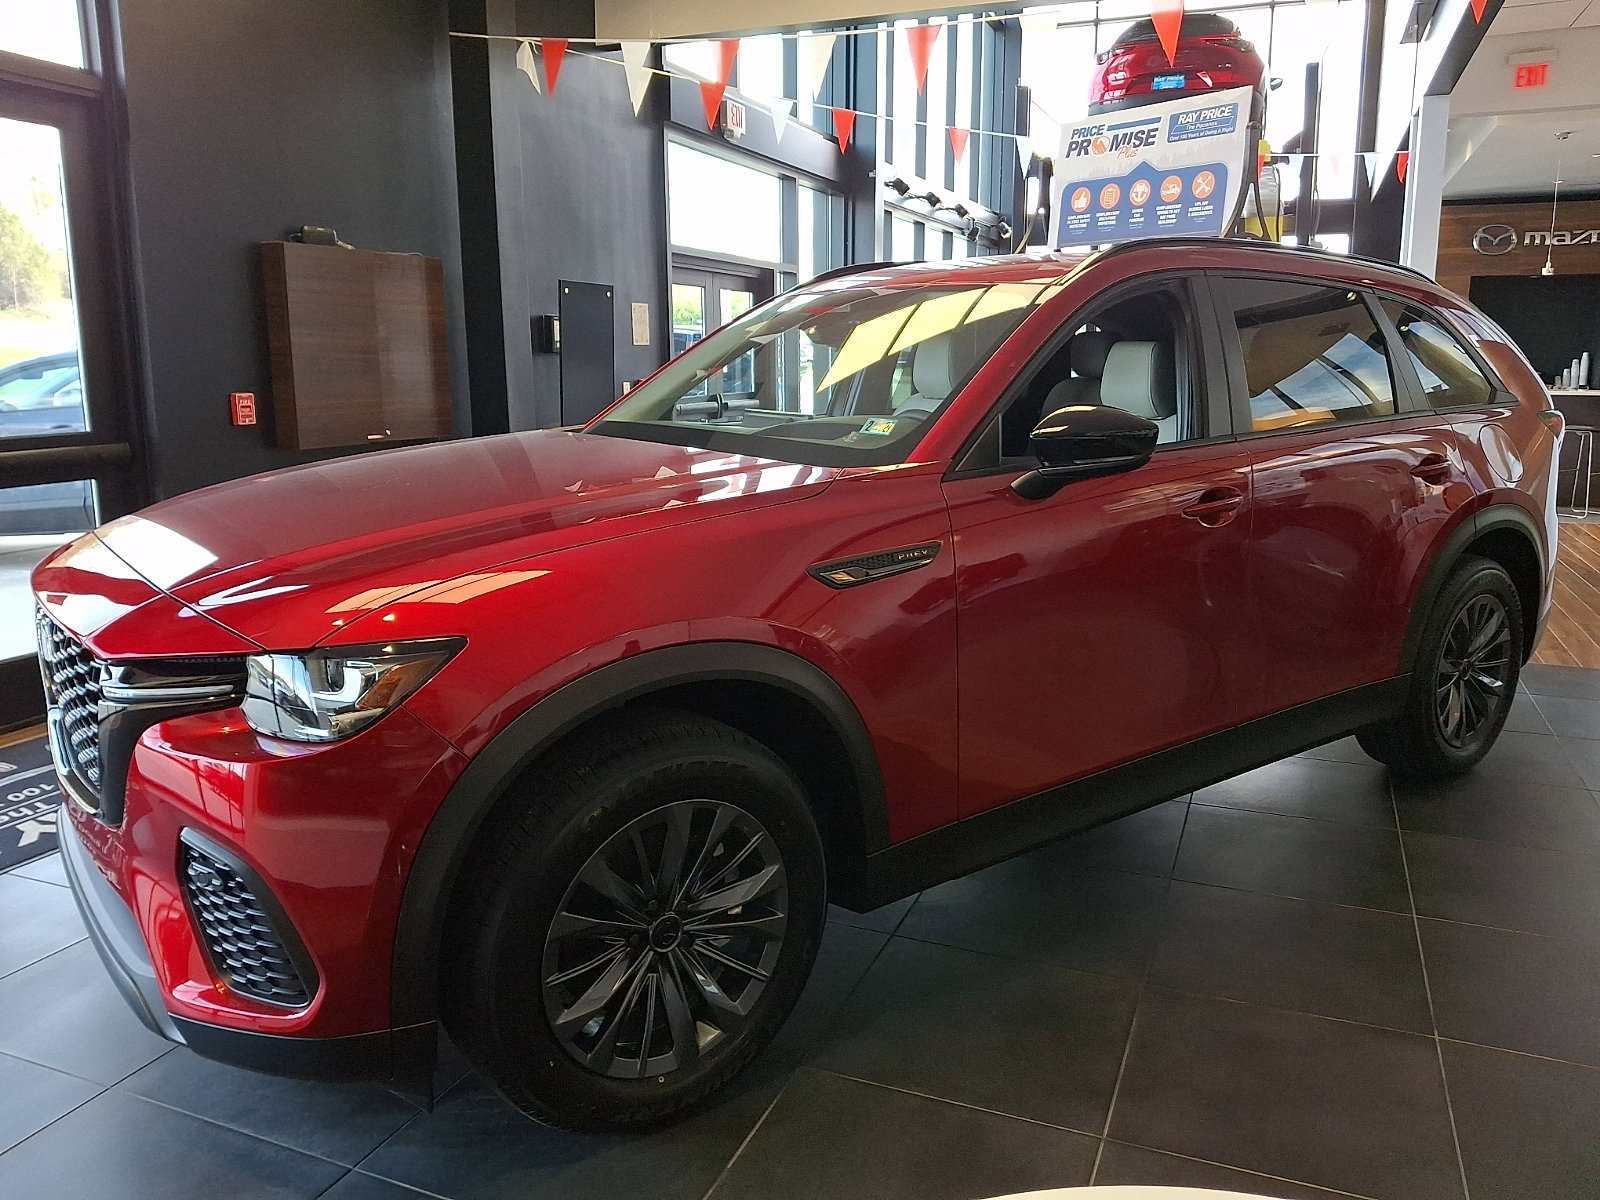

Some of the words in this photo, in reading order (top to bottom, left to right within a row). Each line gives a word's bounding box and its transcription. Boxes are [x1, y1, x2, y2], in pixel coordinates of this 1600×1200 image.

[1515, 64, 1549, 88] EXIT
[1178, 112, 1200, 124] RAY
[1200, 105, 1234, 120] PRICE
[1070, 124, 1106, 140] PRICE
[1116, 145, 1139, 159] Plus
[898, 549, 928, 560] PHEV
